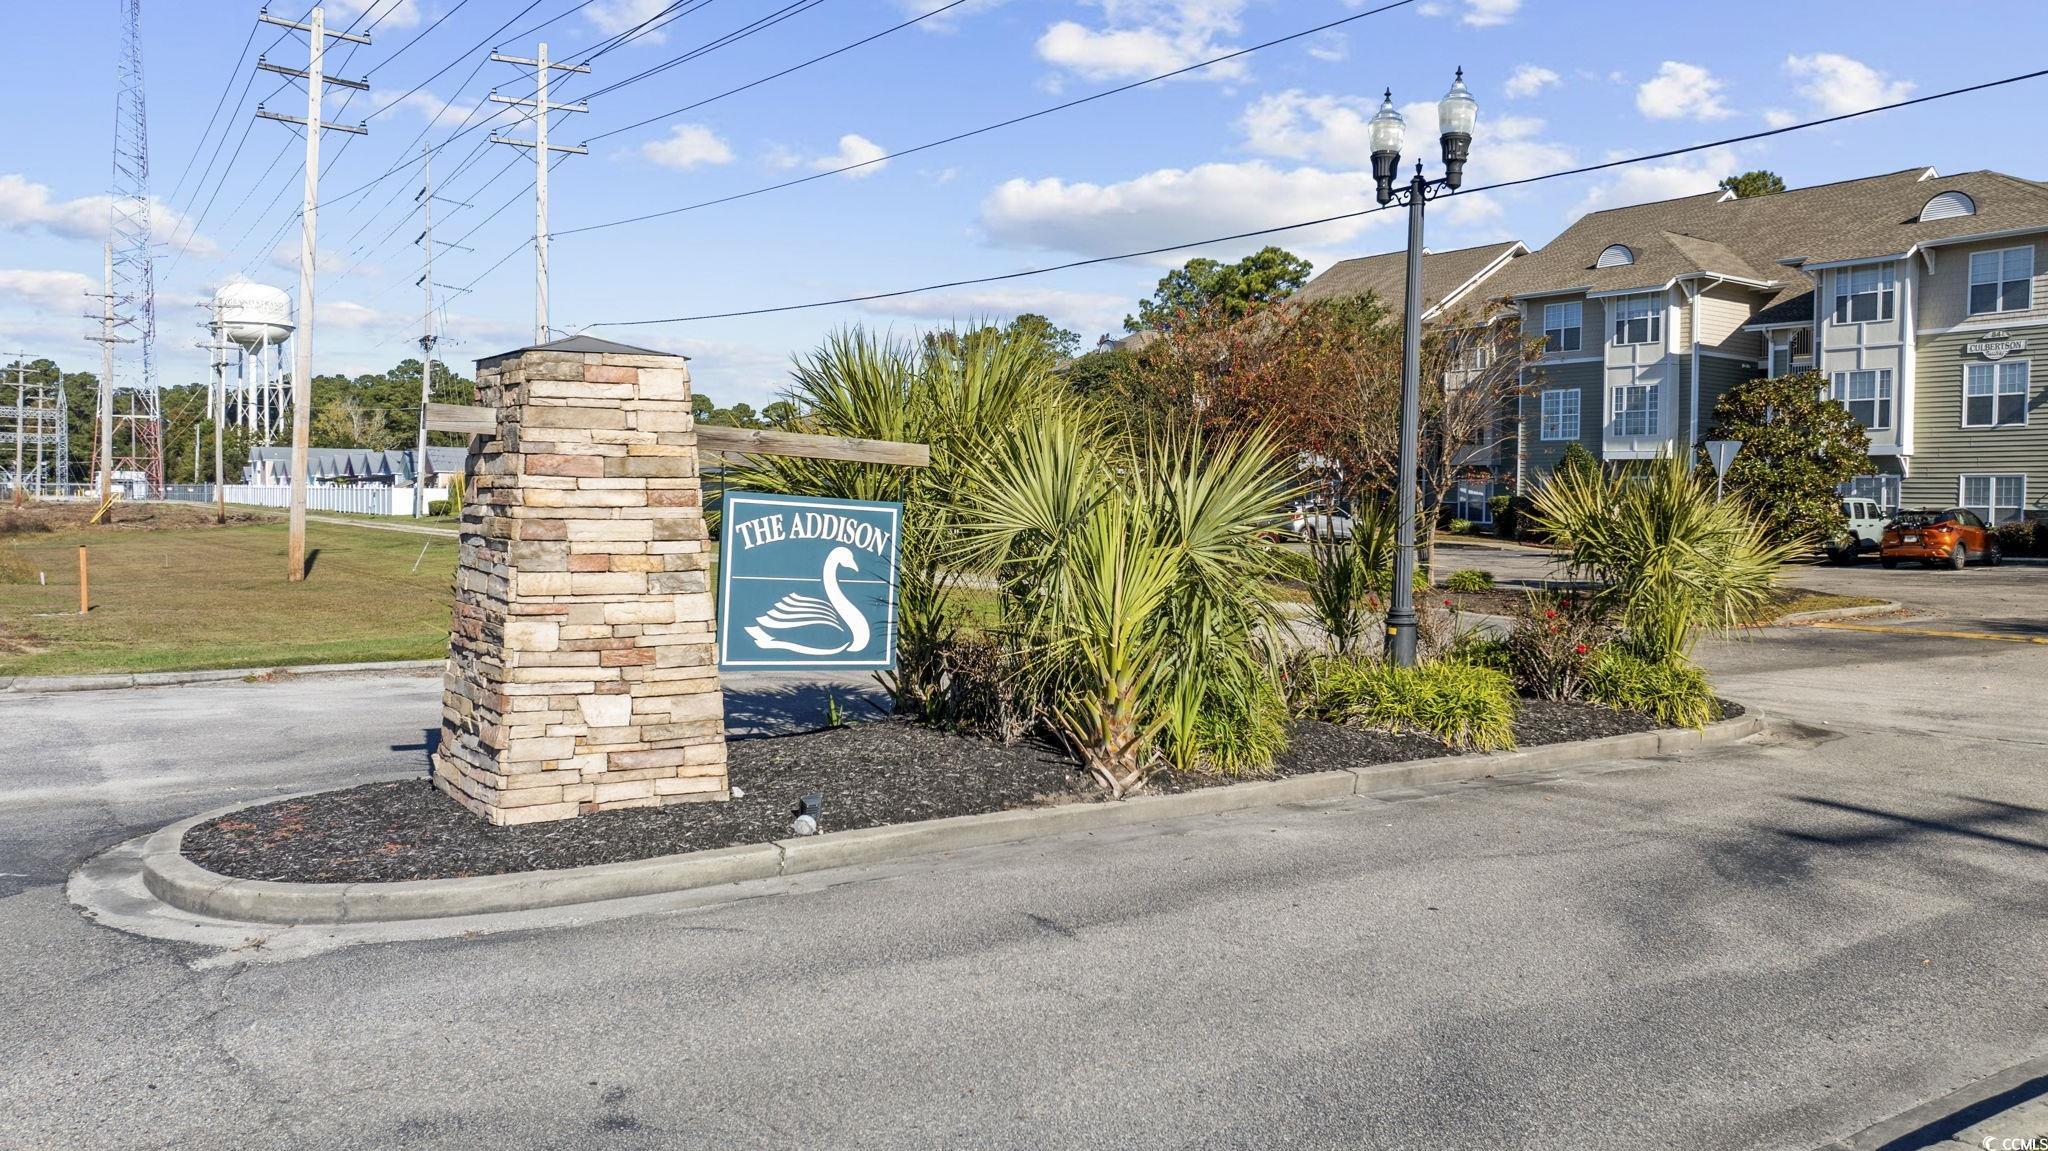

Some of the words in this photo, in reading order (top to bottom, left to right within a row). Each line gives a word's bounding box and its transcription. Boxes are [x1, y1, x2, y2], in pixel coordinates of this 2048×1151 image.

[1969, 341, 2022, 352] CULBERTSON
[735, 514, 786, 550] THE
[789, 512, 890, 556] ADDISON
